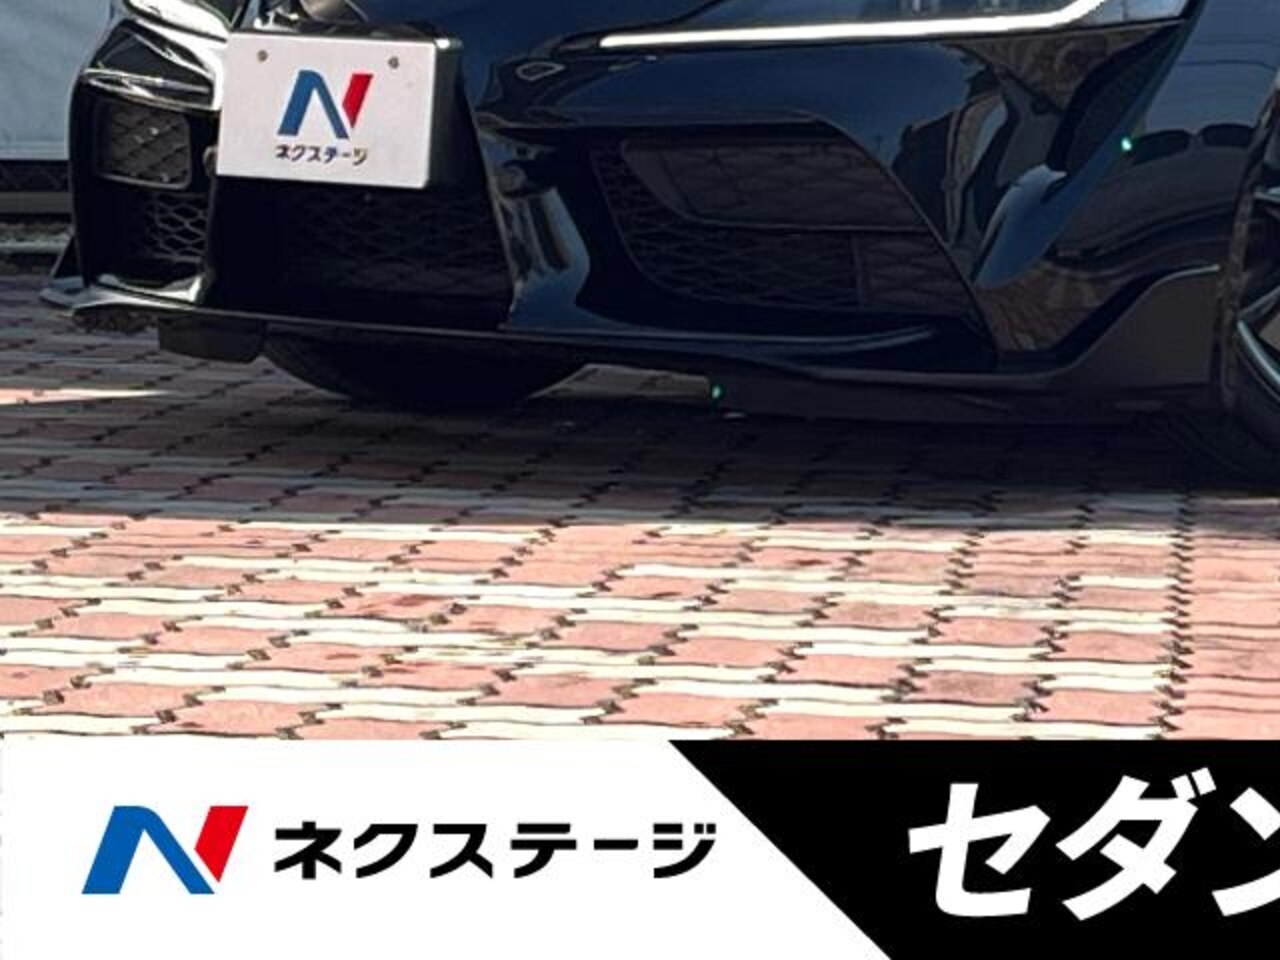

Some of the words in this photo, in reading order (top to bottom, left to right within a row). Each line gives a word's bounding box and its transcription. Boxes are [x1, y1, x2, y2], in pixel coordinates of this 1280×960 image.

[277, 69, 374, 140] N
[275, 143, 368, 166] ネクステージ
